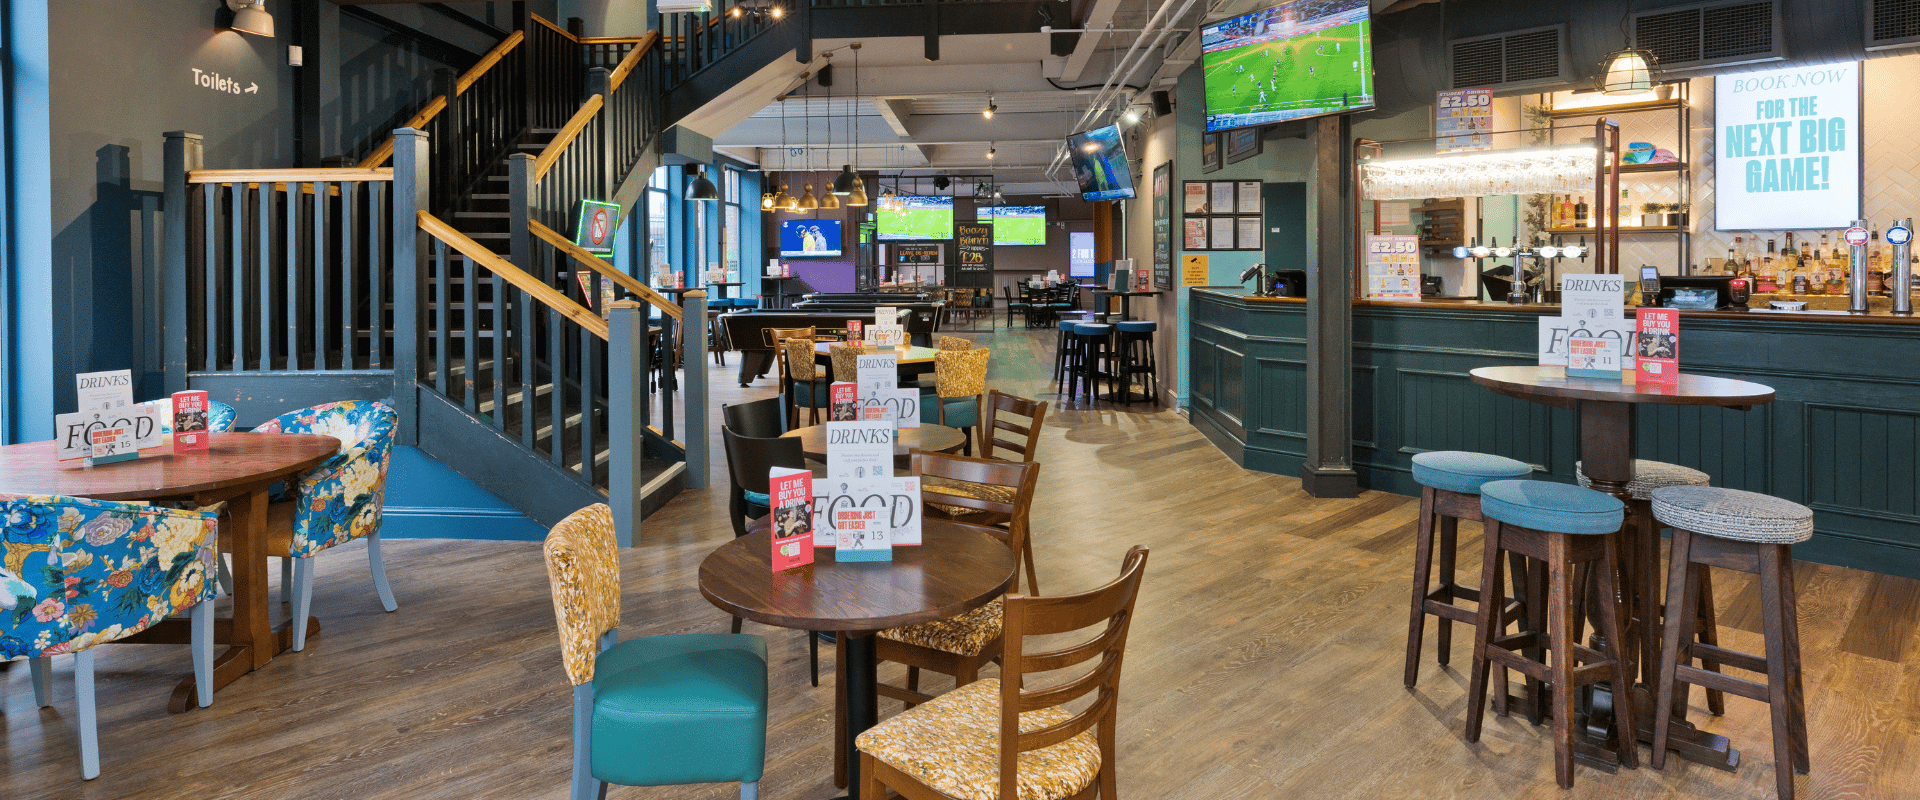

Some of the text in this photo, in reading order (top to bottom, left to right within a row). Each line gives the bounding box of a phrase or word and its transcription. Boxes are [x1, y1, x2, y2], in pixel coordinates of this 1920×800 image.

[192, 68, 240, 94] Toilets
[1732, 68, 1848, 93] BOOK NOW
[1440, 94, 1490, 109] £2.50
[1756, 96, 1818, 120] FOR THE
[1726, 117, 1846, 158] NEXT BIG
[1746, 156, 1830, 193] GAME!
[1371, 241, 1416, 254] £2.50
[1564, 278, 1621, 292] DRINKS
[1644, 312, 1668, 320] LET ME
[1642, 320, 1670, 328] BUY YOU
[1648, 327, 1670, 336] DRINK
[858, 358, 896, 369] DRINKS
[1602, 356, 1612, 364] 11
[79, 374, 129, 389] DRINKS
[180, 396, 190, 404] LET
[829, 428, 890, 444] DRINKS
[120, 440, 131, 449] 15
[780, 478, 804, 491] LET ME
[778, 486, 806, 501] BUY YOU
[778, 496, 806, 510] A DRINK
[872, 530, 884, 540] 13
